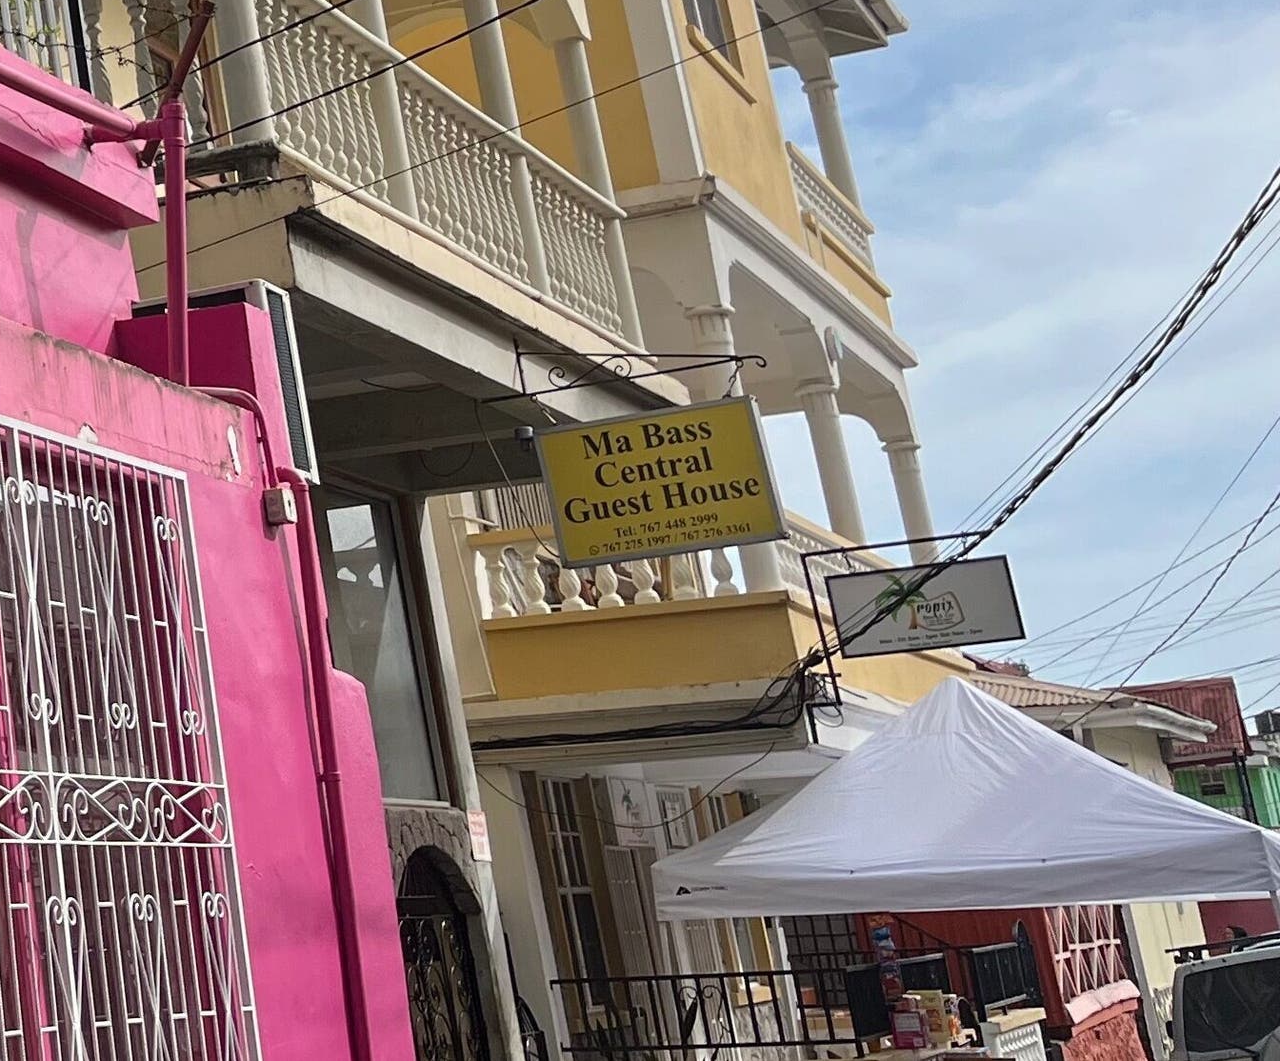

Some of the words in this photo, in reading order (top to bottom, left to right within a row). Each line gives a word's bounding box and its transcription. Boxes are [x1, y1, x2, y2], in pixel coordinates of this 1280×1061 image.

[580, 430, 634, 460] Ma
[640, 420, 713, 451] Bass
[594, 446, 713, 487] Central
[564, 490, 654, 524] Guest
[662, 476, 760, 510] House
[614, 525, 636, 539] Tel:
[640, 521, 661, 535] 767
[665, 517, 687, 530] 448
[690, 513, 719, 527] 2999
